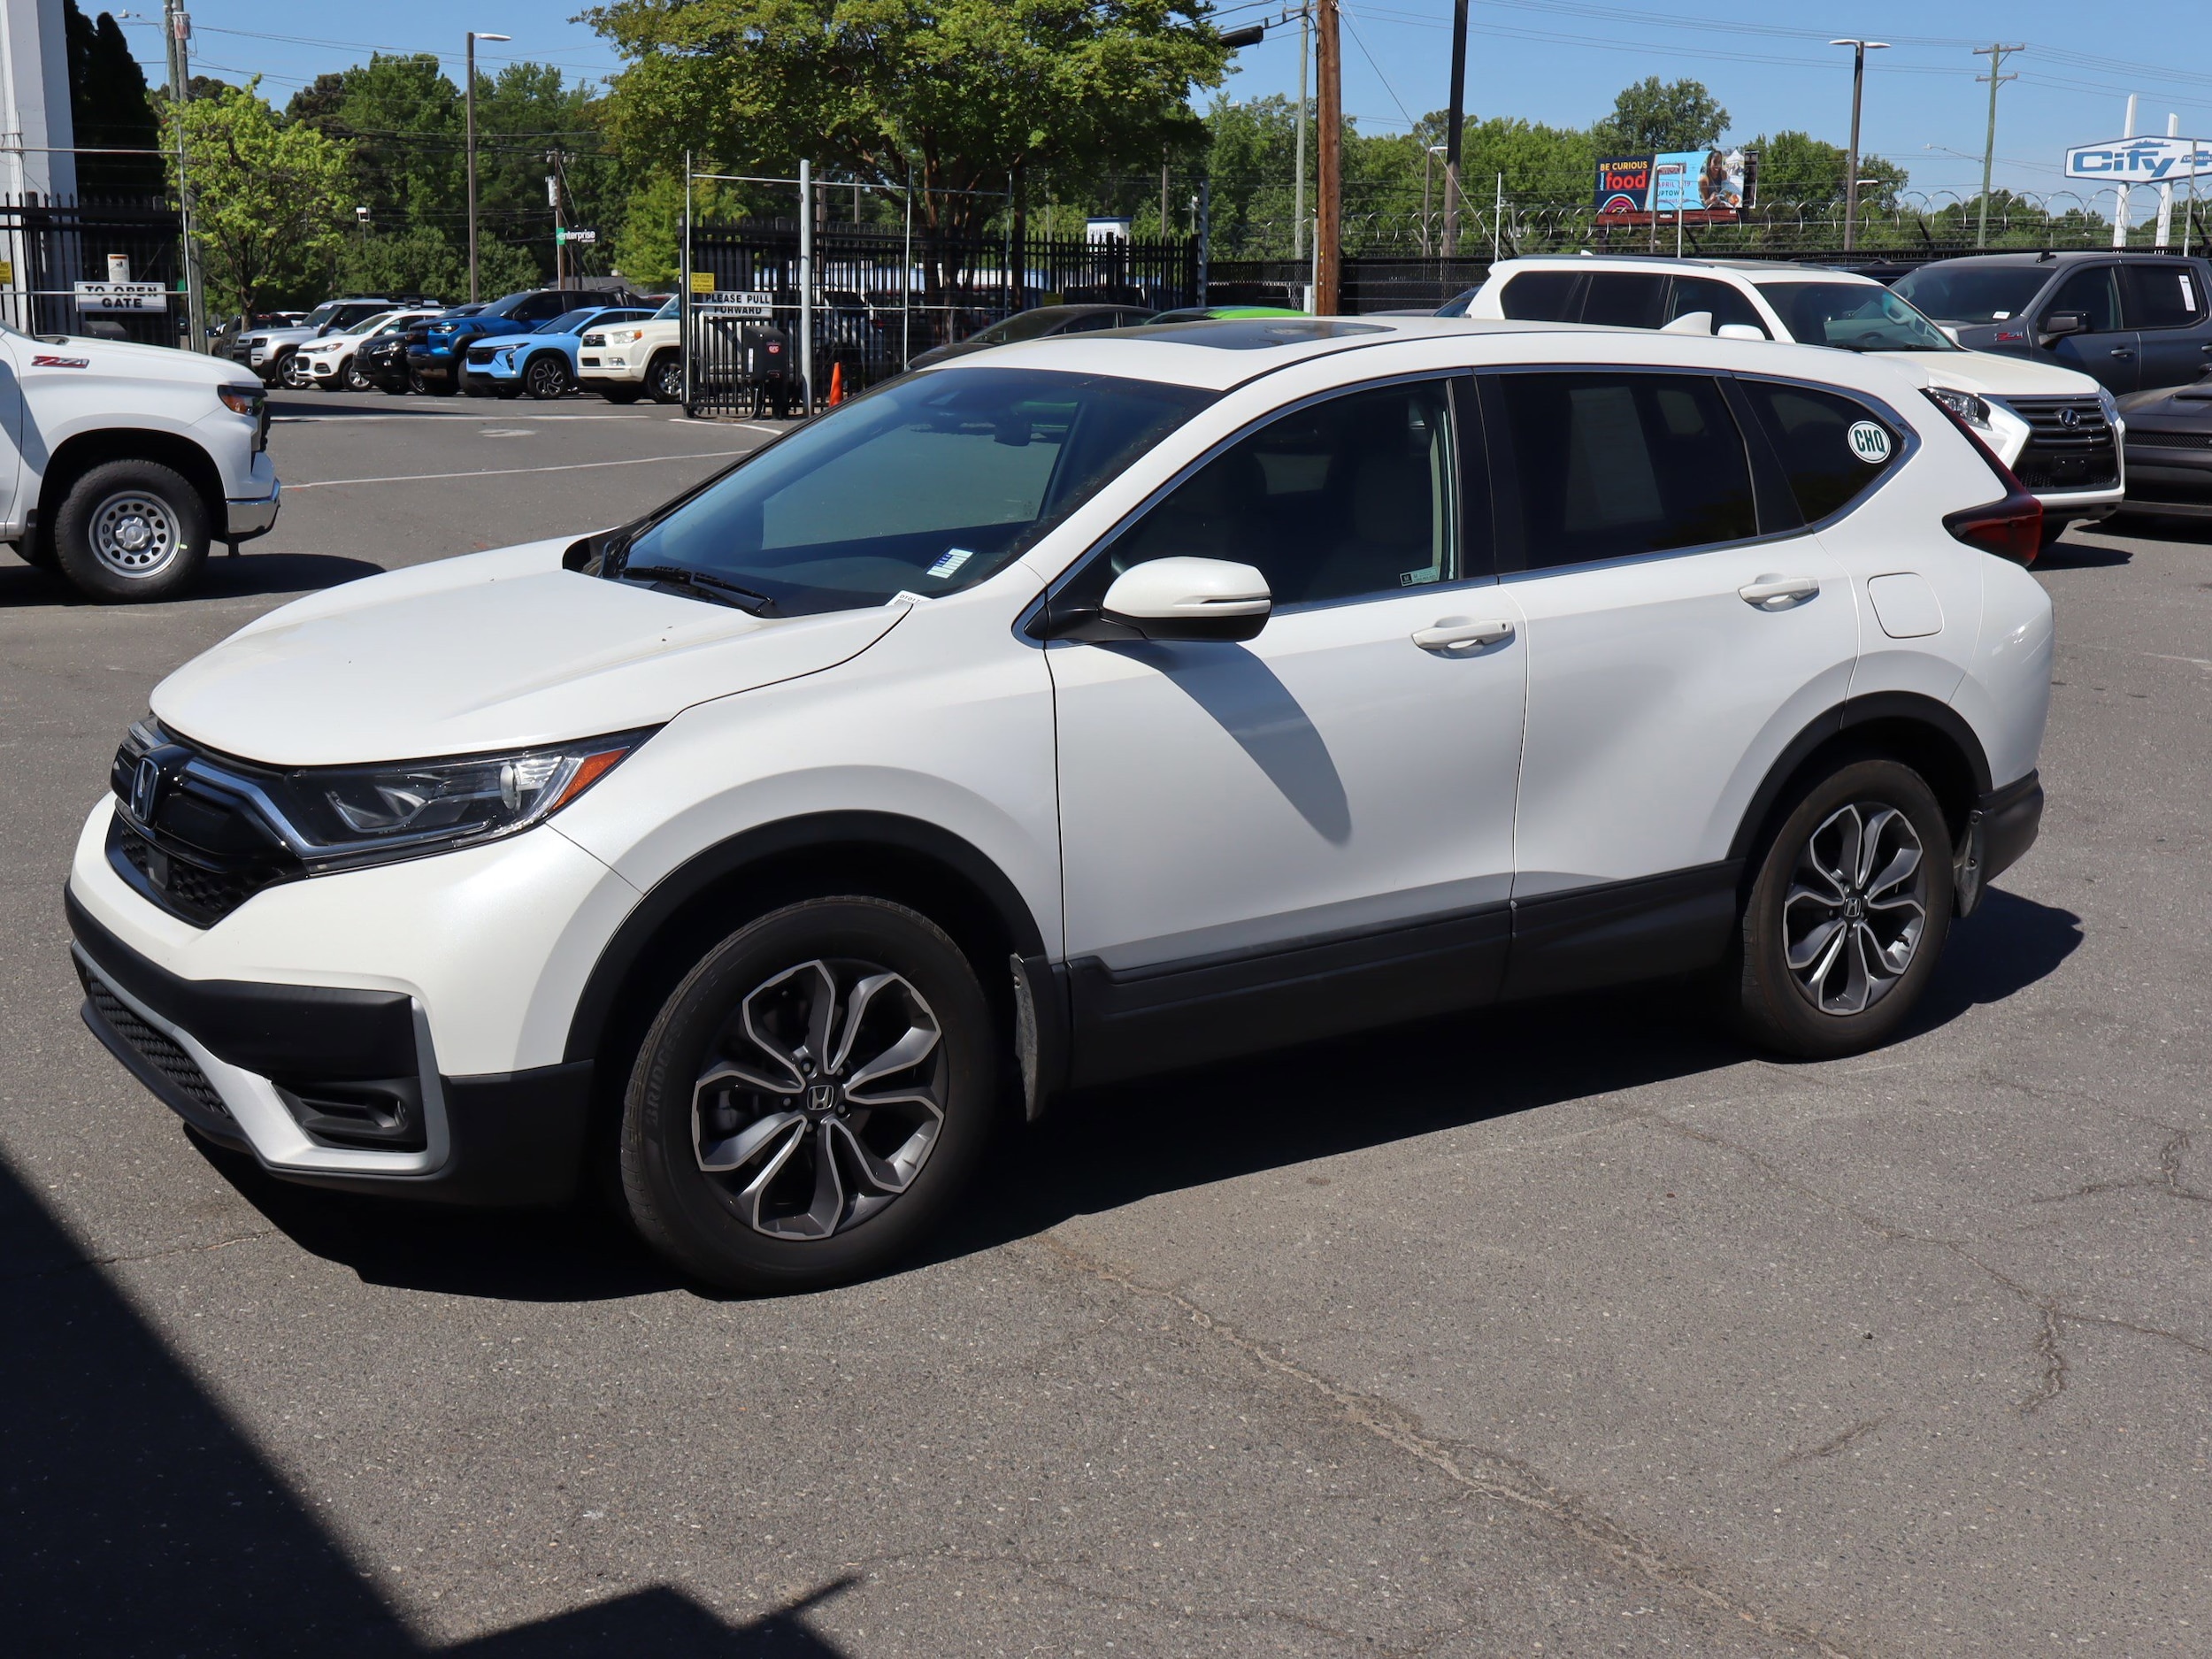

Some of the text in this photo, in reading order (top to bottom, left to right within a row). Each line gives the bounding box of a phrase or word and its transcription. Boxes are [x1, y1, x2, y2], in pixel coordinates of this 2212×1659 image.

[1612, 161, 1647, 170] CURIOUS
[2073, 150, 2176, 177] City
[1606, 171, 1646, 189] food
[557, 229, 595, 242] enterprise
[85, 286, 157, 296] TO OPEN
[102, 298, 143, 308] GATE
[705, 294, 770, 303] PLEASE PULL
[1855, 430, 1886, 453] CHQ
